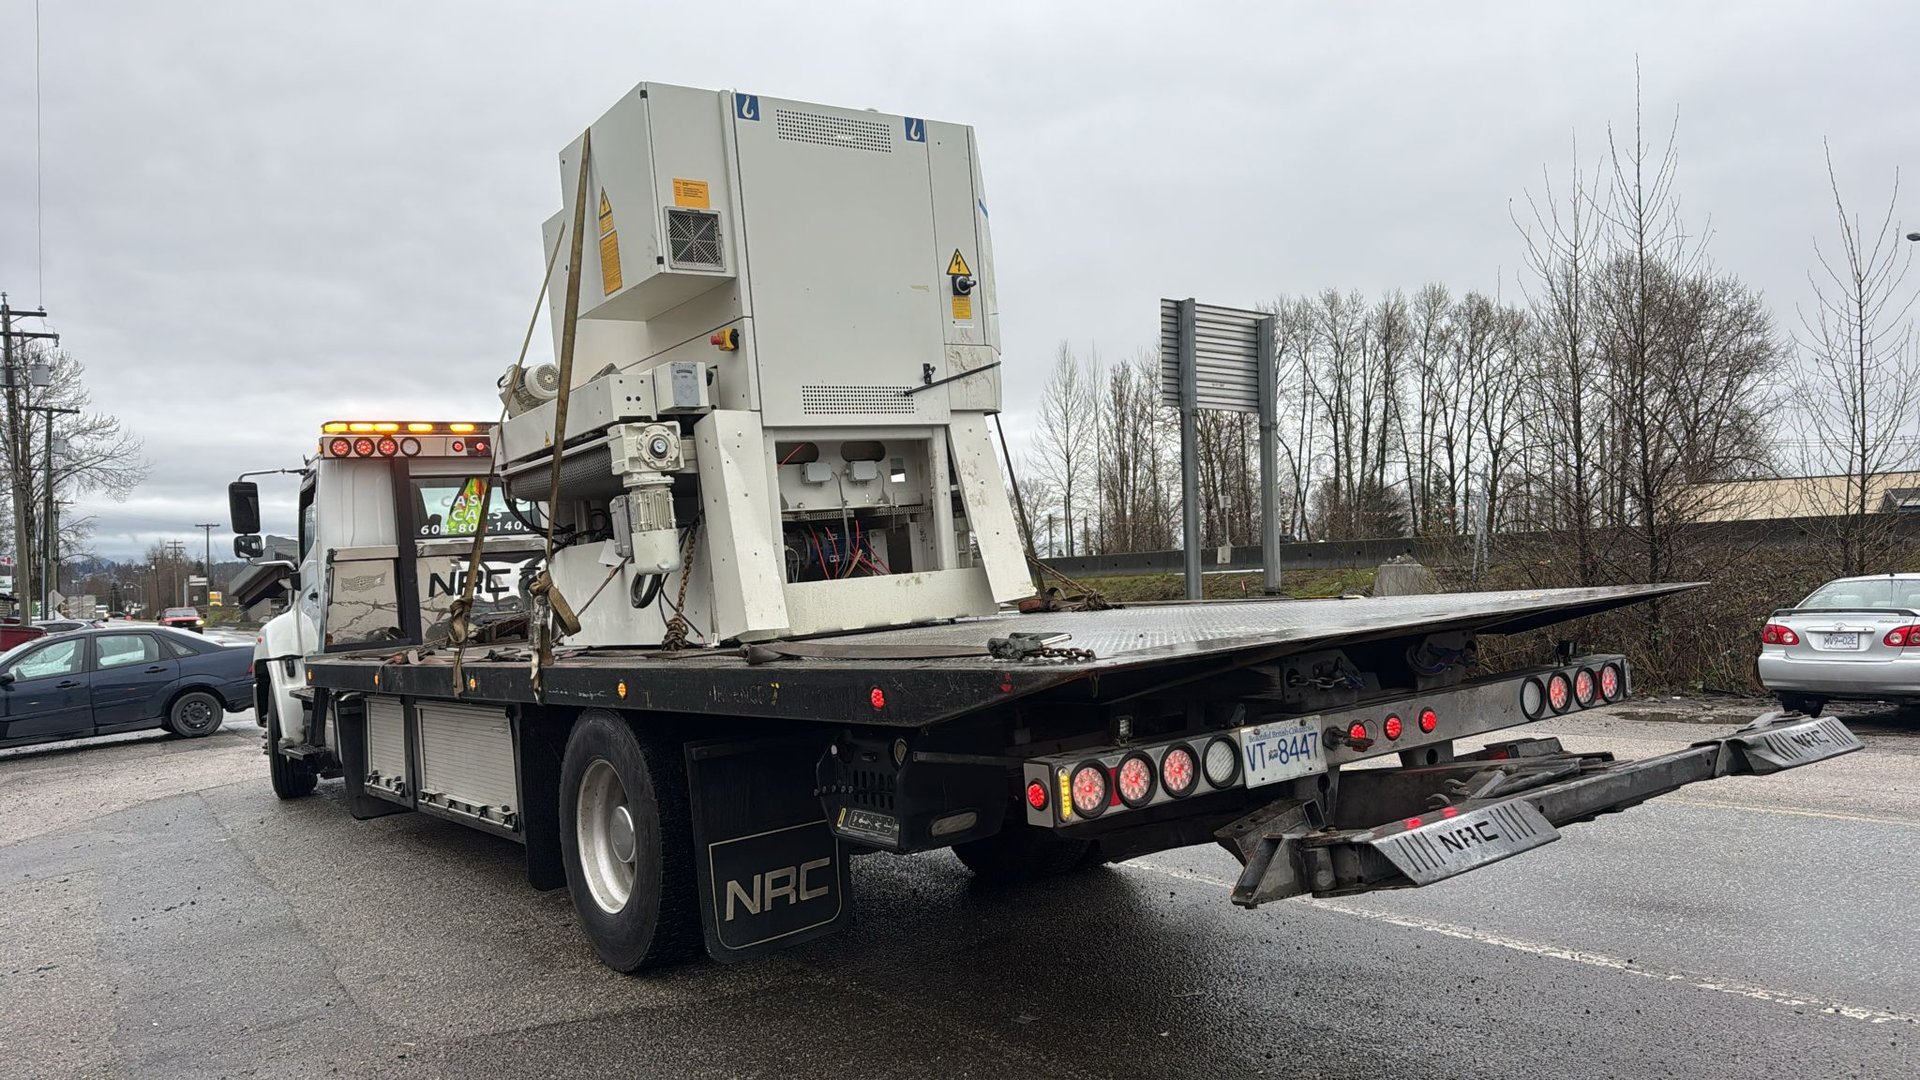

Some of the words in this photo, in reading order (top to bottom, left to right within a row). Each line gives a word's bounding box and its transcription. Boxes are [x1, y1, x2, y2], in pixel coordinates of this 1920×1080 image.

[452, 509, 502, 521] CAS
[429, 569, 511, 597] NRC
[1249, 731, 1271, 742] Beautiful
[1272, 728, 1289, 738] British
[1790, 729, 1830, 750] NRC
[1246, 743, 1265, 771] VT
[1278, 732, 1317, 764] 8447
[1437, 820, 1500, 854] NRC
[724, 856, 831, 922] NRC
